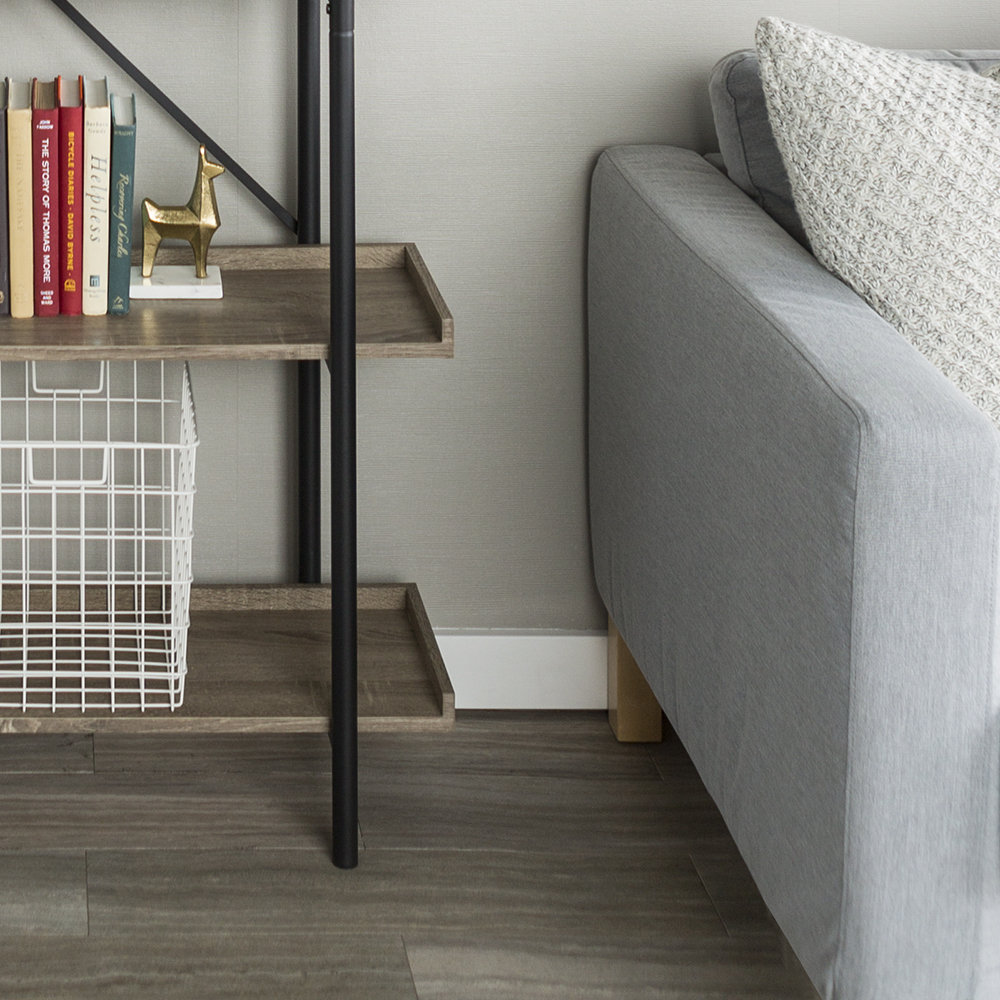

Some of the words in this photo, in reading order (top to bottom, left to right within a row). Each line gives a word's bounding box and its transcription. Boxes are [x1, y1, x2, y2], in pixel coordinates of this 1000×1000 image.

[41, 138, 50, 158] THE
[67, 131, 75, 168] BICYCLE
[42, 160, 50, 193] STORY
[67, 170, 75, 205] DIARIES
[42, 194, 50, 209] OF
[86, 154, 108, 243] Helpless
[112, 172, 129, 221] Recovering
[42, 211, 50, 252] THOMAS
[116, 222, 130, 258] Charles
[43, 254, 51, 283] MORE
